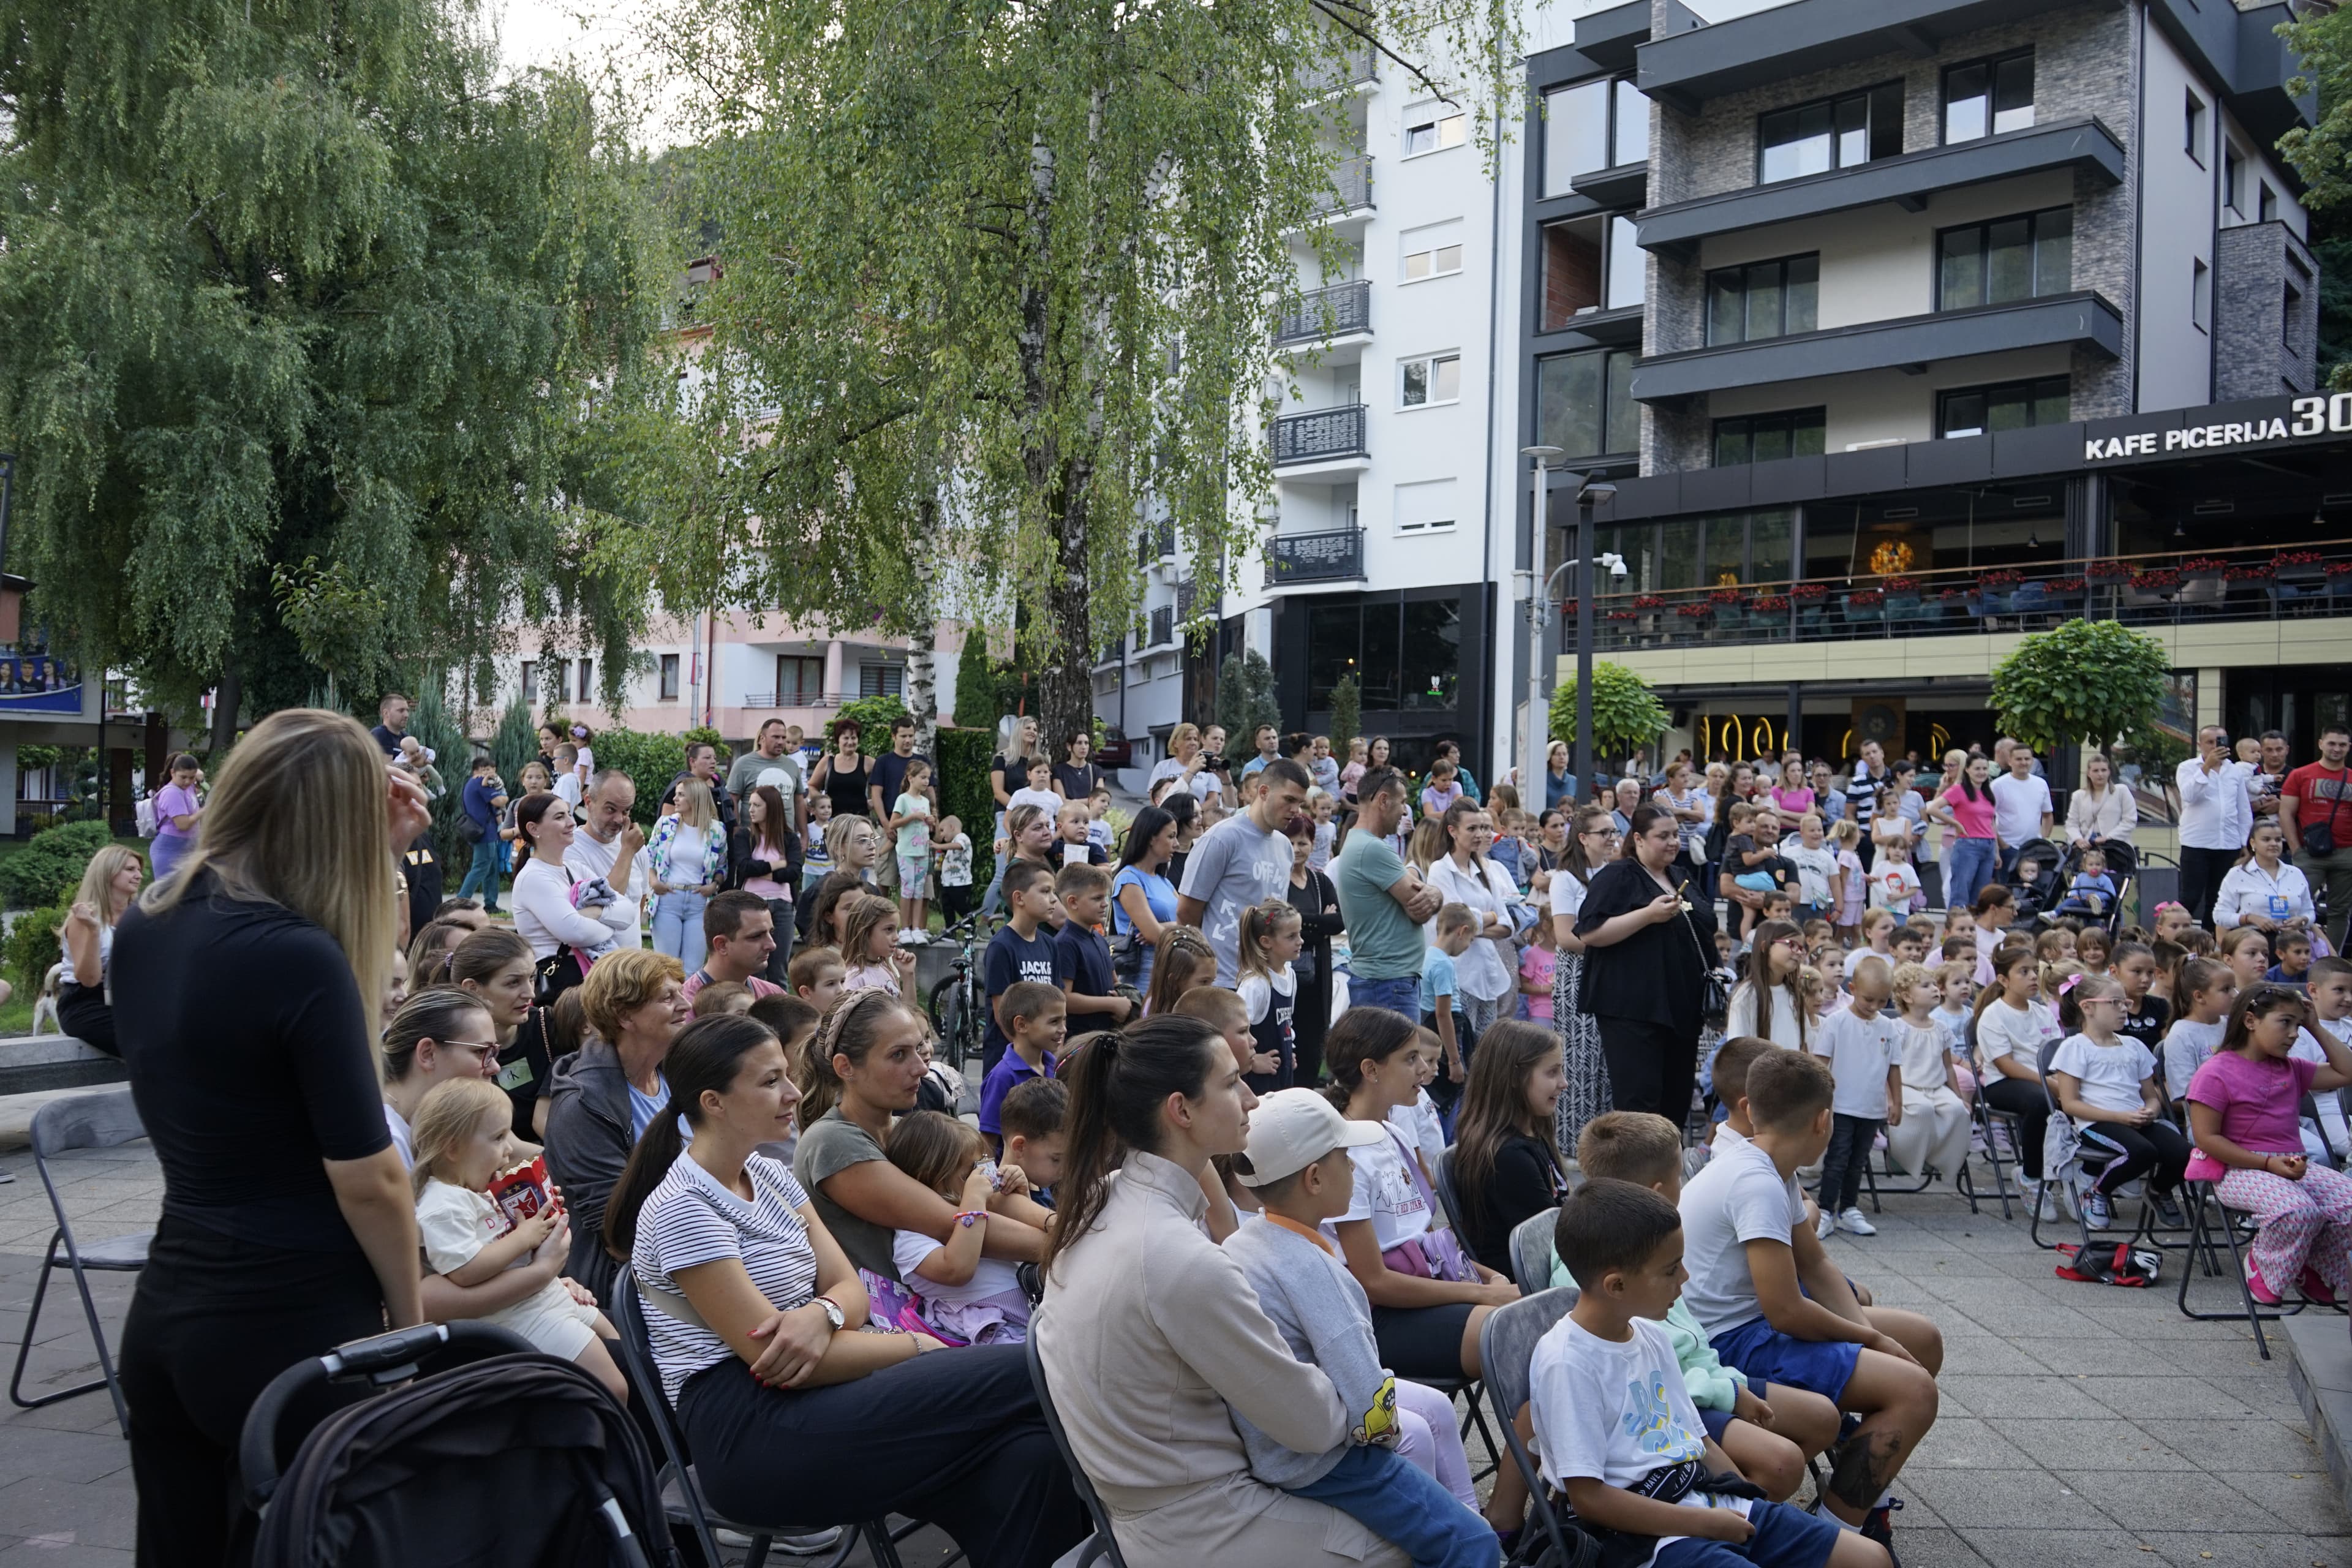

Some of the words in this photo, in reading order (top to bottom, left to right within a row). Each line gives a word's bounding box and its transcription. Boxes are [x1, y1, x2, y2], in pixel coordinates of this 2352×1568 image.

[2086, 432, 2158, 460] KAFE
[2165, 417, 2288, 451] PICERIJA
[1020, 960, 1052, 975] JACK&
[1410, 1199, 1423, 1211] STAR
[1643, 1473, 1661, 1490] HAVE
